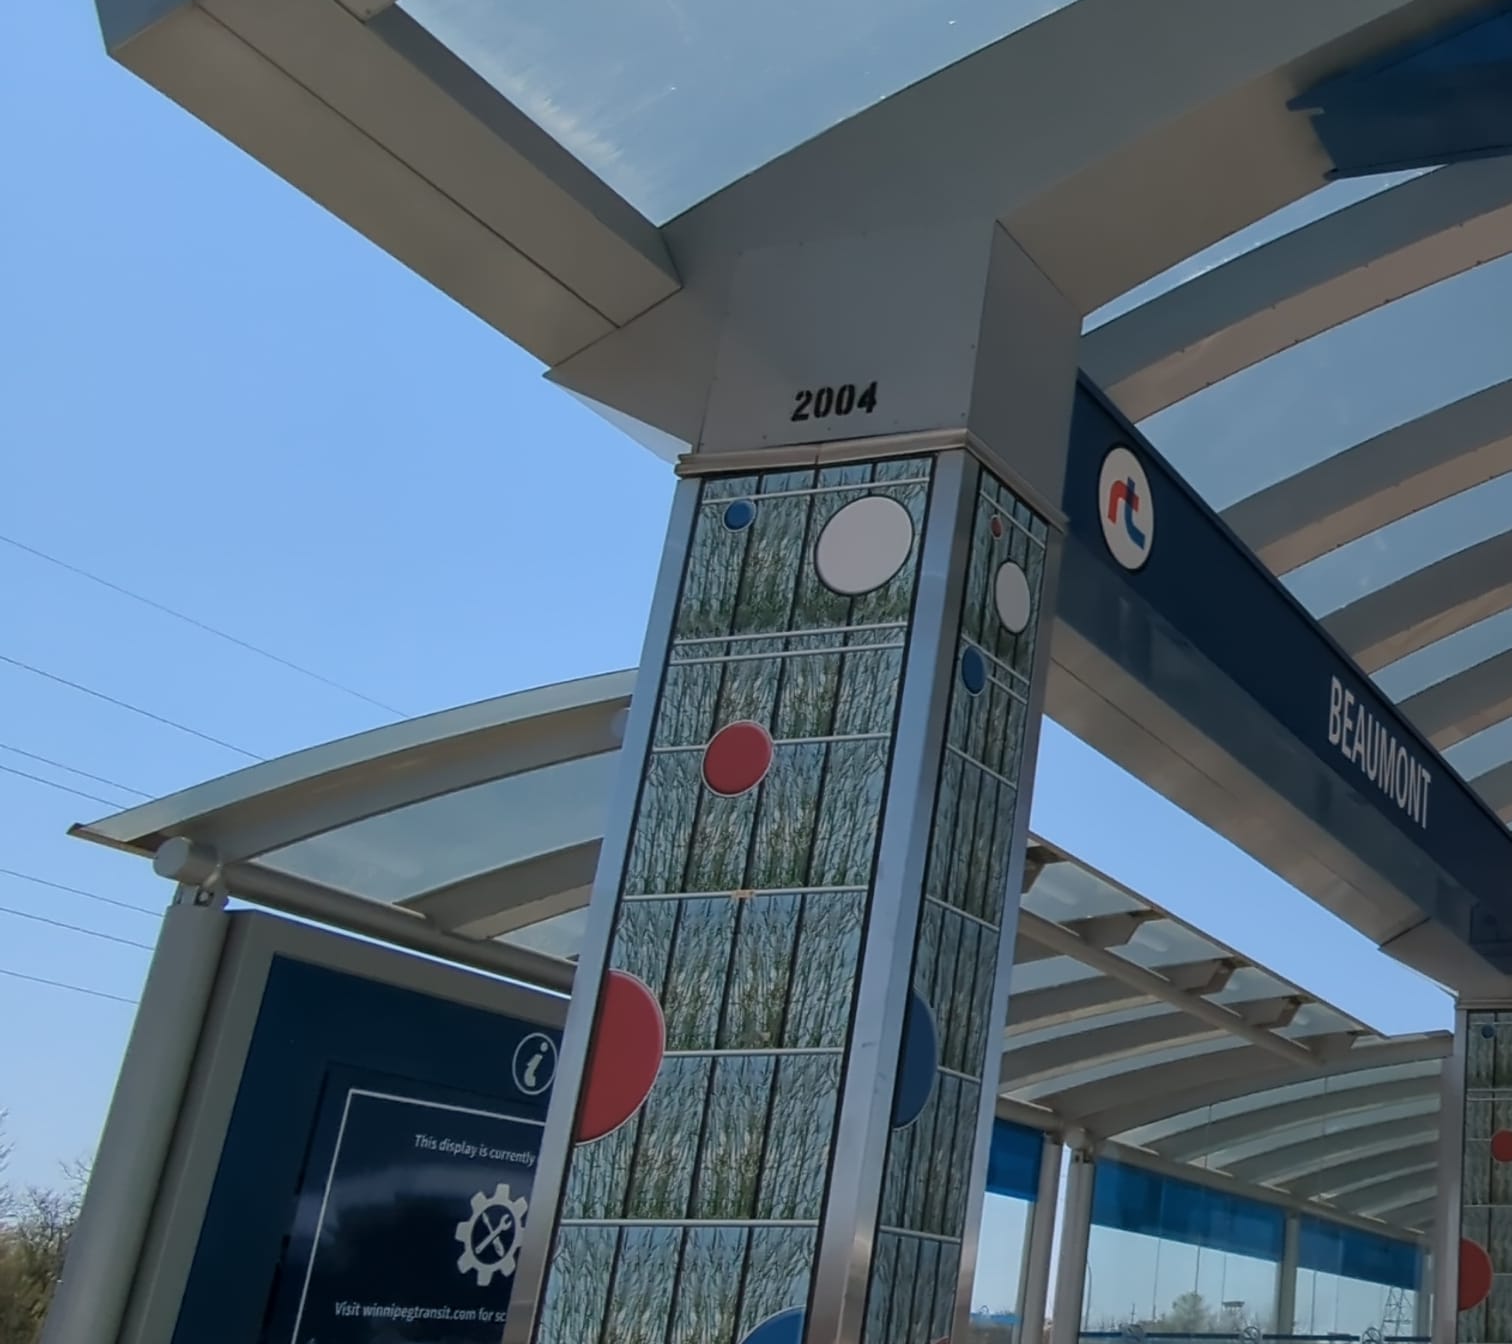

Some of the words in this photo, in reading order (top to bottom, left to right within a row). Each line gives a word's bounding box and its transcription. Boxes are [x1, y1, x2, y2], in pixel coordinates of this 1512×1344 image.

[790, 380, 878, 422] 2004
[1328, 674, 1432, 830] BEAUMONT
[413, 1133, 438, 1151] This
[438, 1138, 478, 1160] display
[478, 1143, 488, 1158] is
[488, 1146, 536, 1169] currently
[334, 1300, 361, 1317] Visit
[362, 1302, 477, 1323] winnipegtransit.com
[478, 1306, 493, 1321] for
